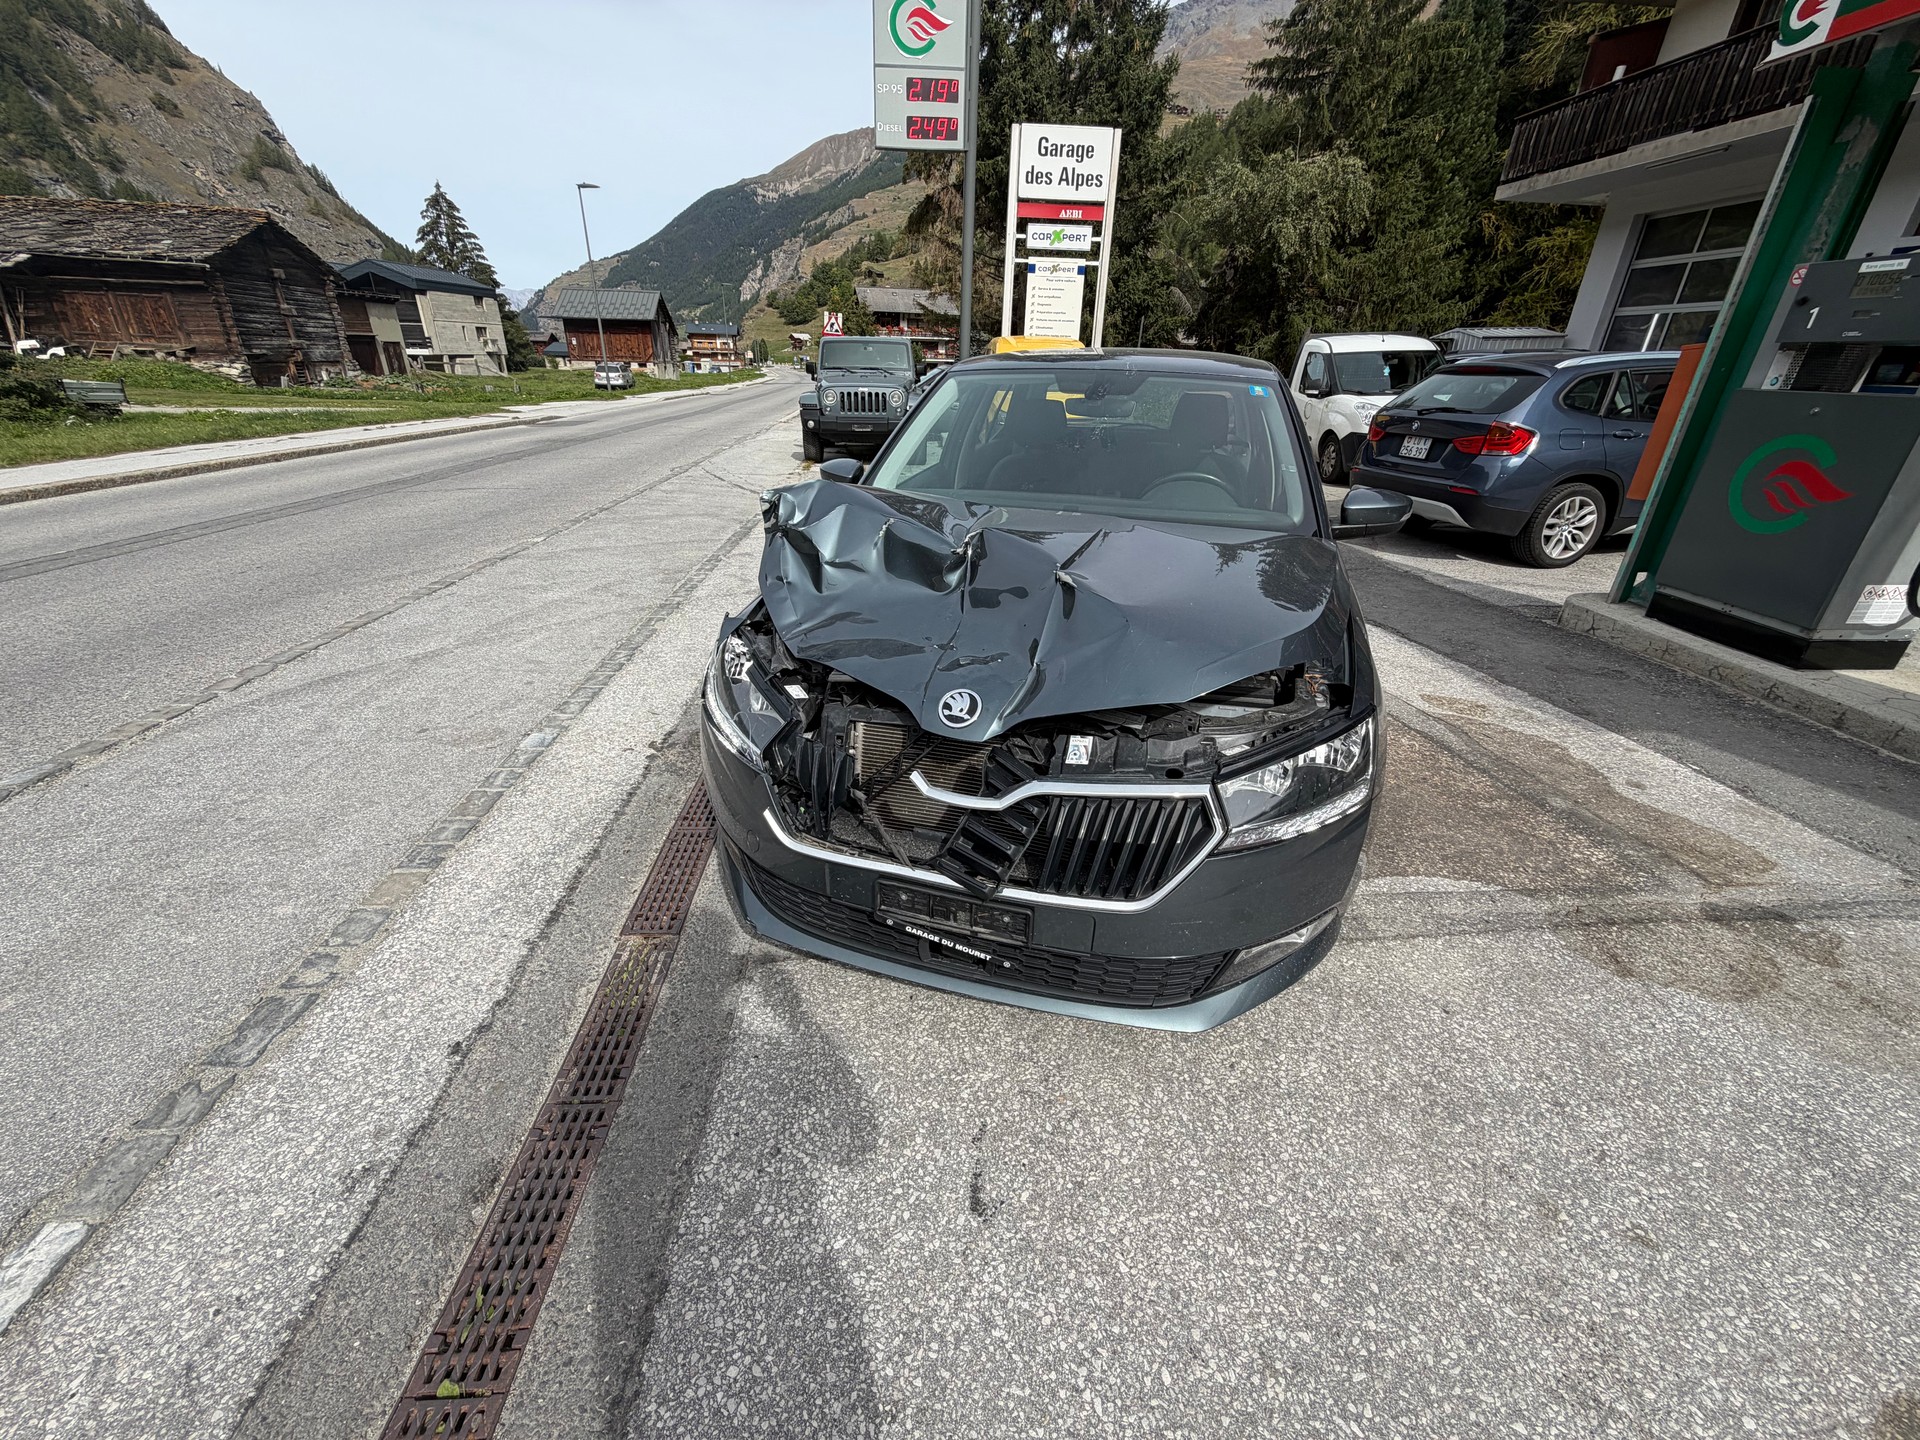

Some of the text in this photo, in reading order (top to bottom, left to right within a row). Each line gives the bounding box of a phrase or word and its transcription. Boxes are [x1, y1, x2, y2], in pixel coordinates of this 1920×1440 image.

[877, 84, 903, 94] SP 95
[1037, 136, 1095, 163] Garage
[1025, 164, 1104, 192] des Alpes
[1806, 306, 1820, 329] 1
[905, 925, 992, 961] GARAGE DU MOURET
